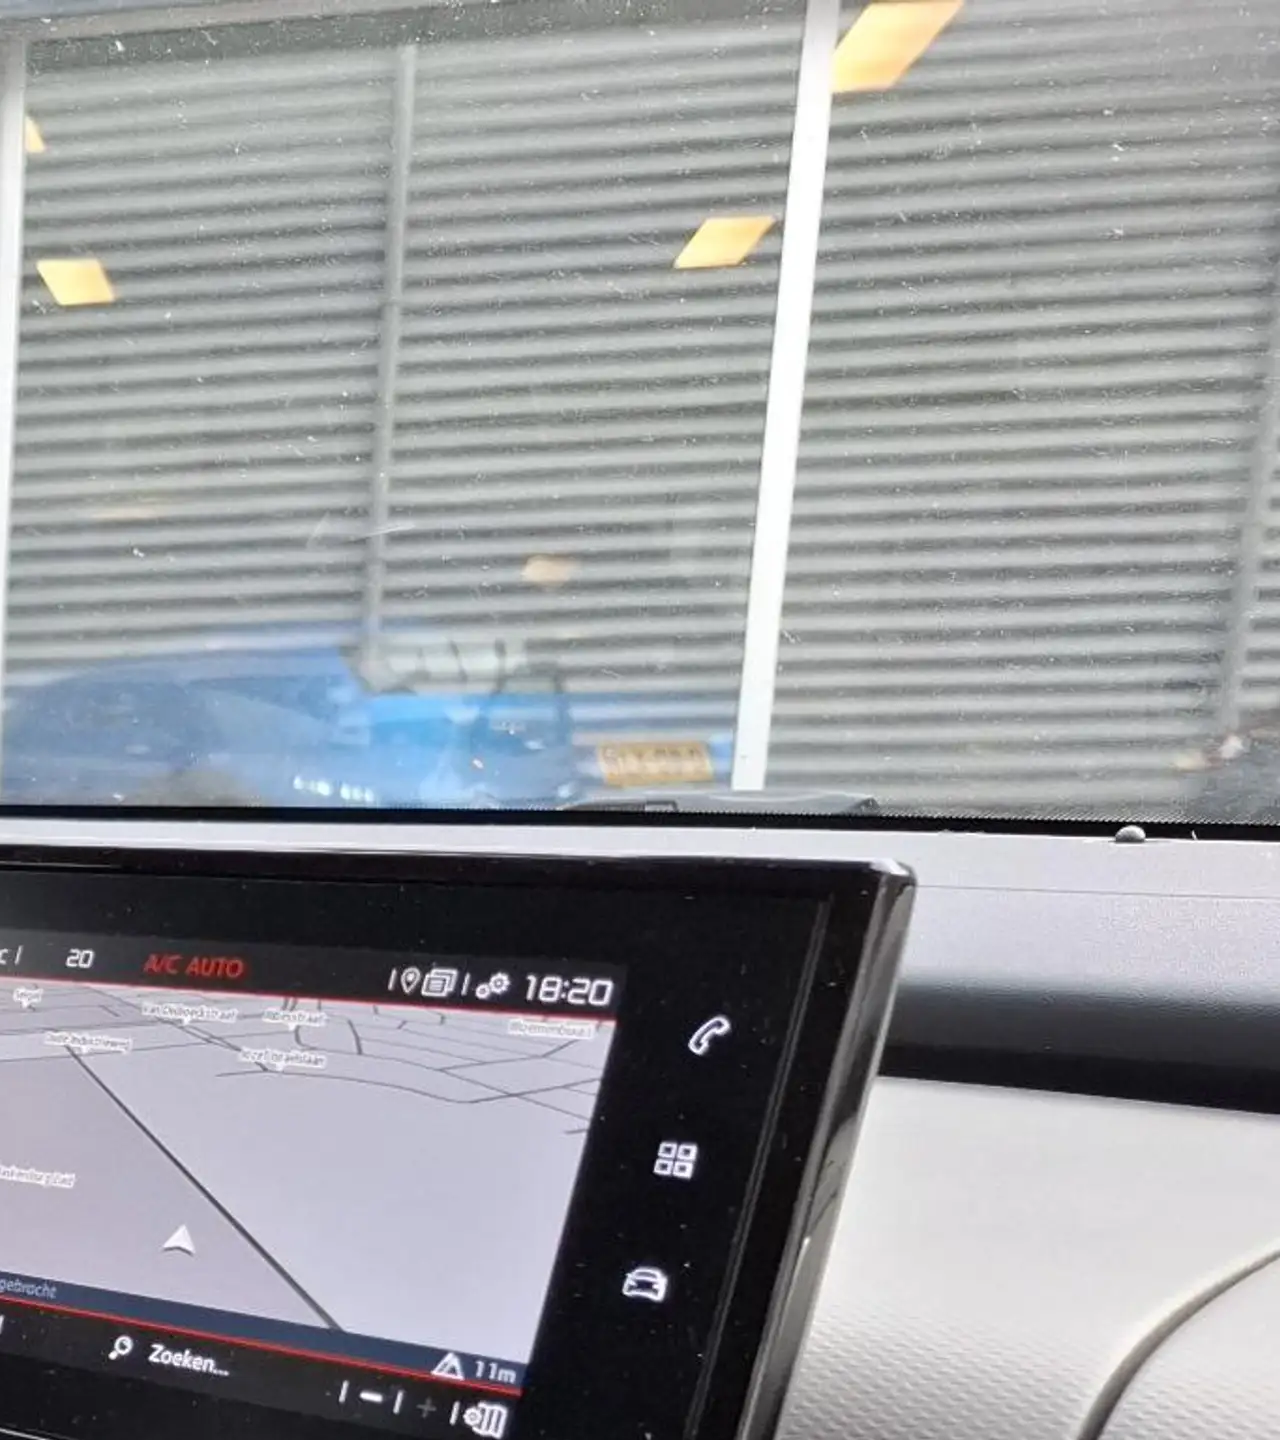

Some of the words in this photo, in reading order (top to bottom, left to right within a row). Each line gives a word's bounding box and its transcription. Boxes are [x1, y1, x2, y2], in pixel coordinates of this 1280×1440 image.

[65, 948, 95, 969] 20
[143, 953, 183, 975] A/C
[185, 956, 245, 980] AUTO
[525, 973, 615, 1007] 18:20
[474, 1360, 517, 1384] 11m
